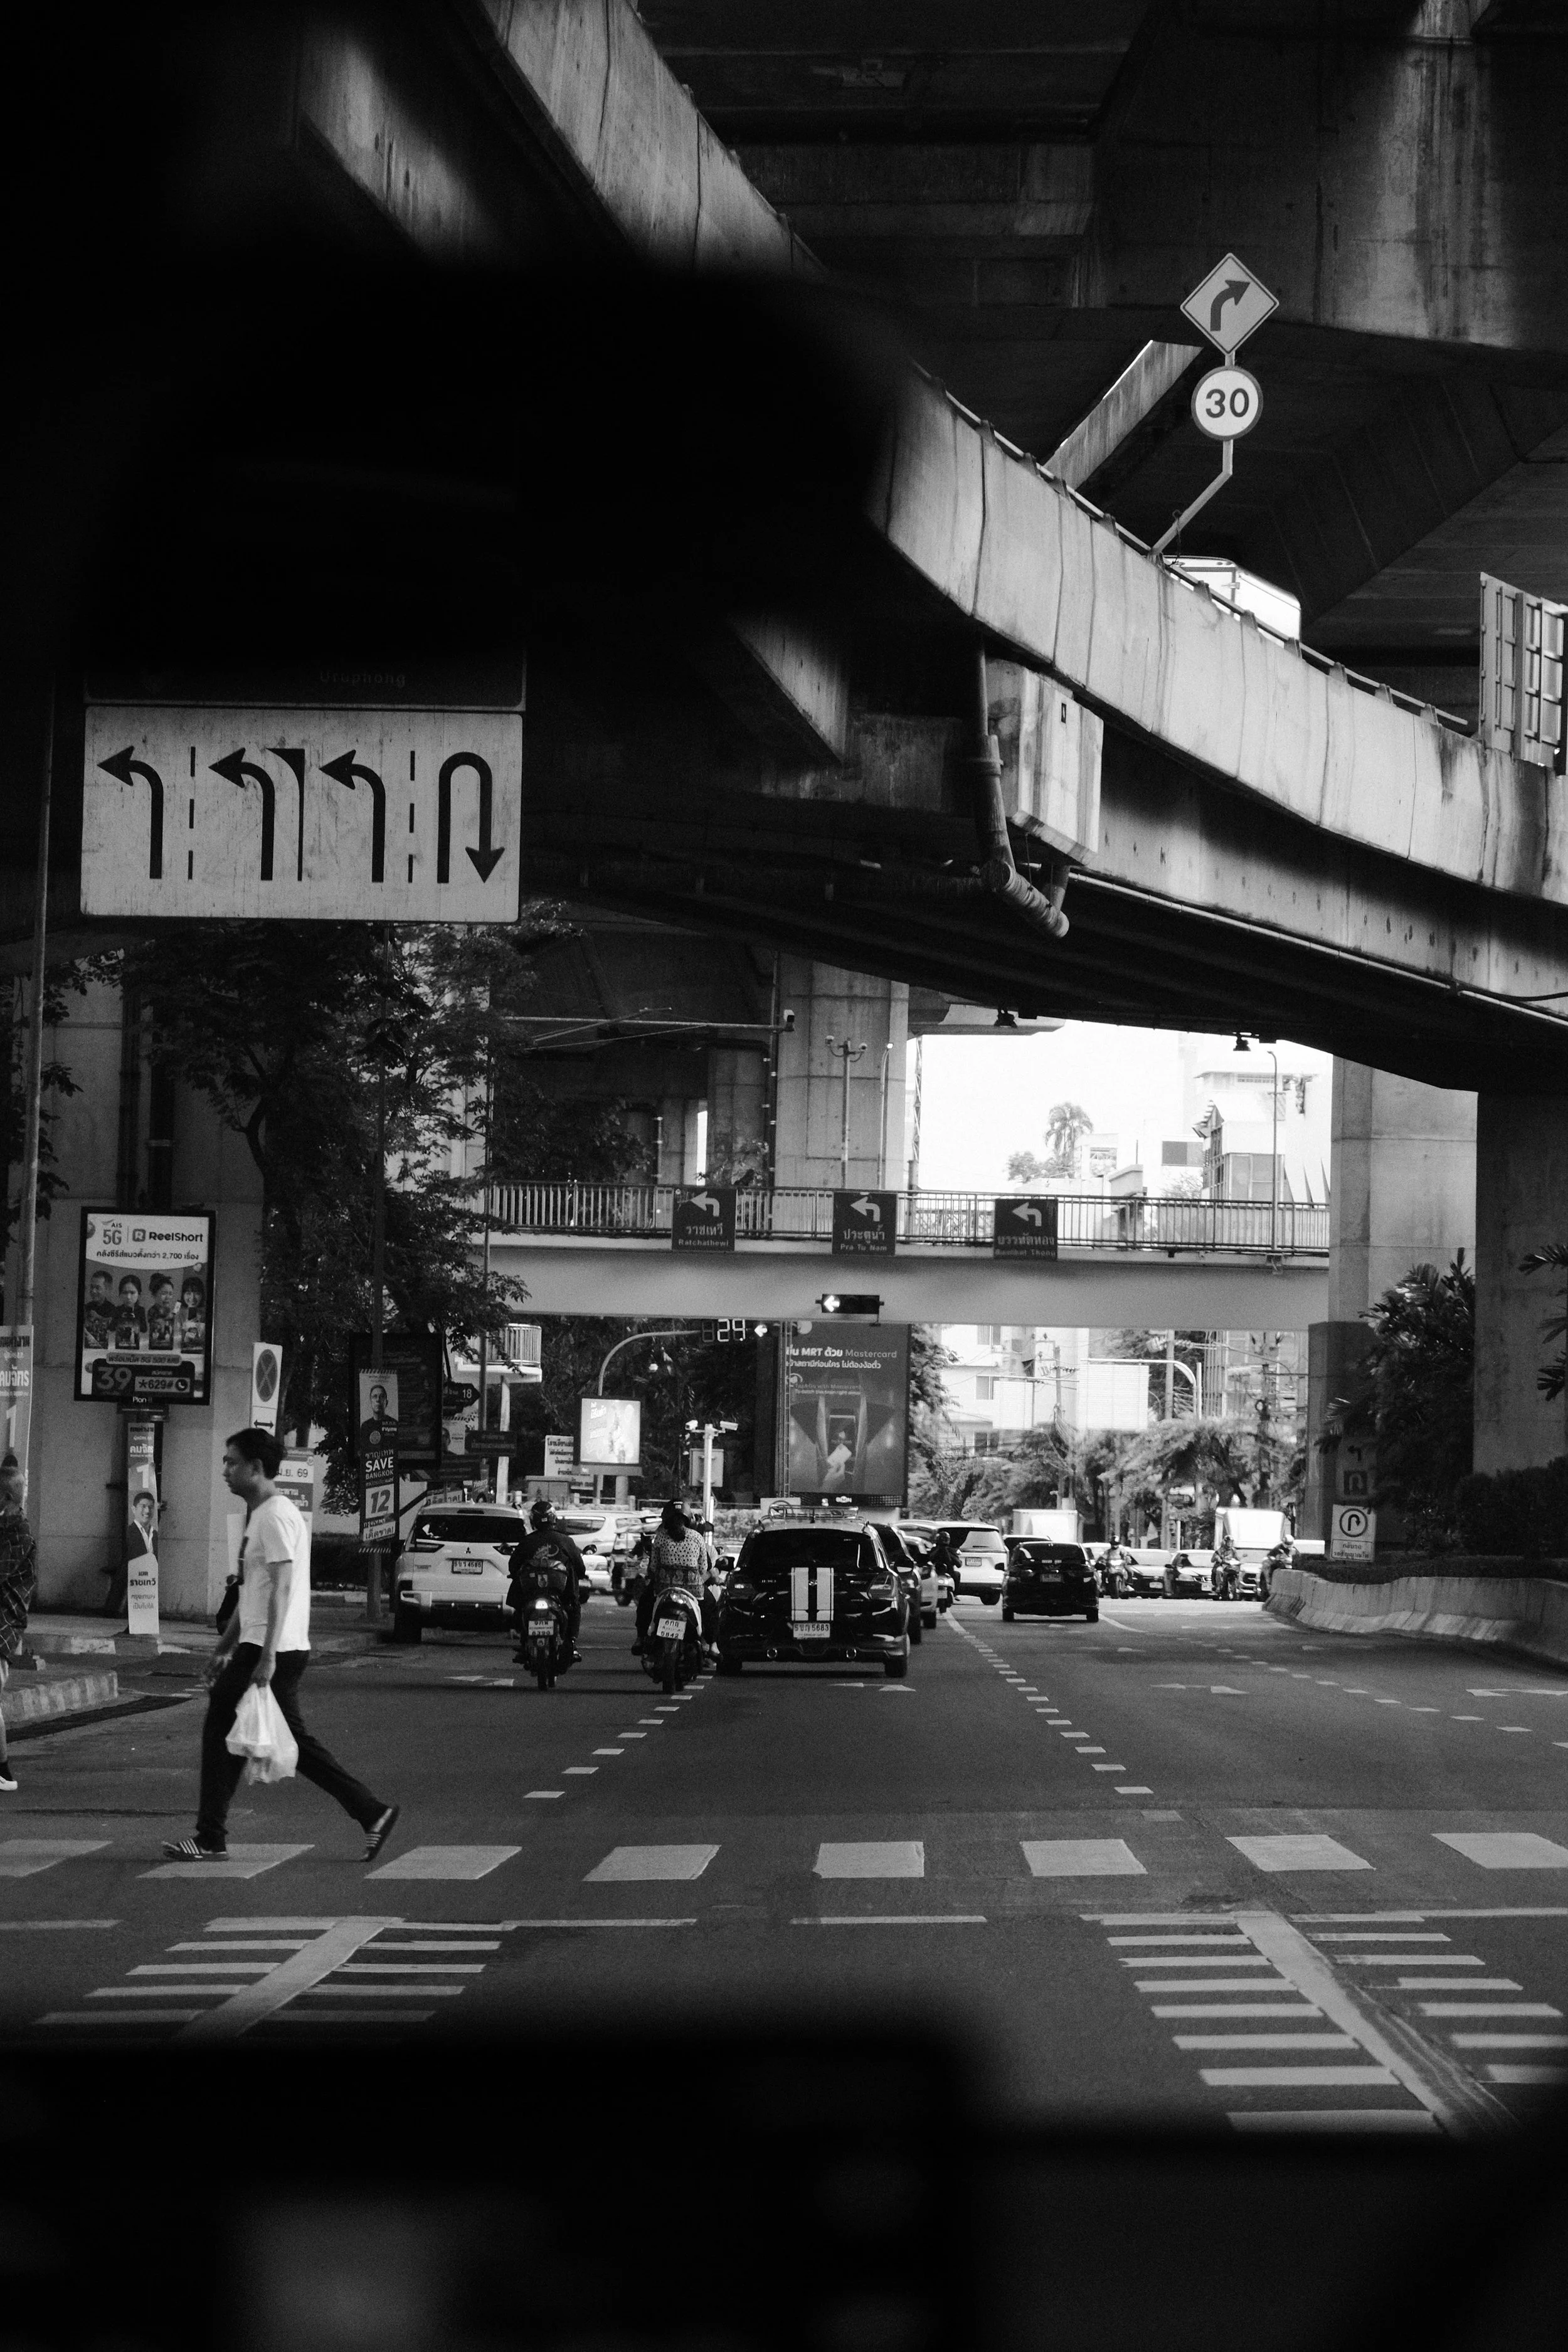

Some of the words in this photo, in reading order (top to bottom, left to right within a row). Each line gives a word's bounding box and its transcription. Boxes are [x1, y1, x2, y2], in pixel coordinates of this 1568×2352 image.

[1205, 388, 1249, 418] 30
[319, 669, 407, 689] Uruphong
[149, 1231, 204, 1242] ReelShort
[686, 1222, 723, 1236] ราชเทวี
[843, 1224, 885, 1244] ประตูน้ำ
[102, 1229, 122, 1245] 5G
[678, 1238, 729, 1246] Ratchathewi
[162, 1252, 183, 1260] 2,700
[801, 1347, 824, 1357] MRT
[825, 1347, 843, 1357] ด้วย
[845, 1349, 898, 1359] Mastercard
[96, 1366, 132, 1391] 39
[462, 1388, 472, 1399] 18
[6, 1404, 17, 1448] 1
[366, 1456, 394, 1473] SAVE
[136, 1463, 150, 1489] 1
[297, 1468, 309, 1478] 69
[366, 1470, 394, 1480] BANGKOK
[371, 1489, 391, 1514] 12
[130, 1577, 156, 1586] ราชเทวี
